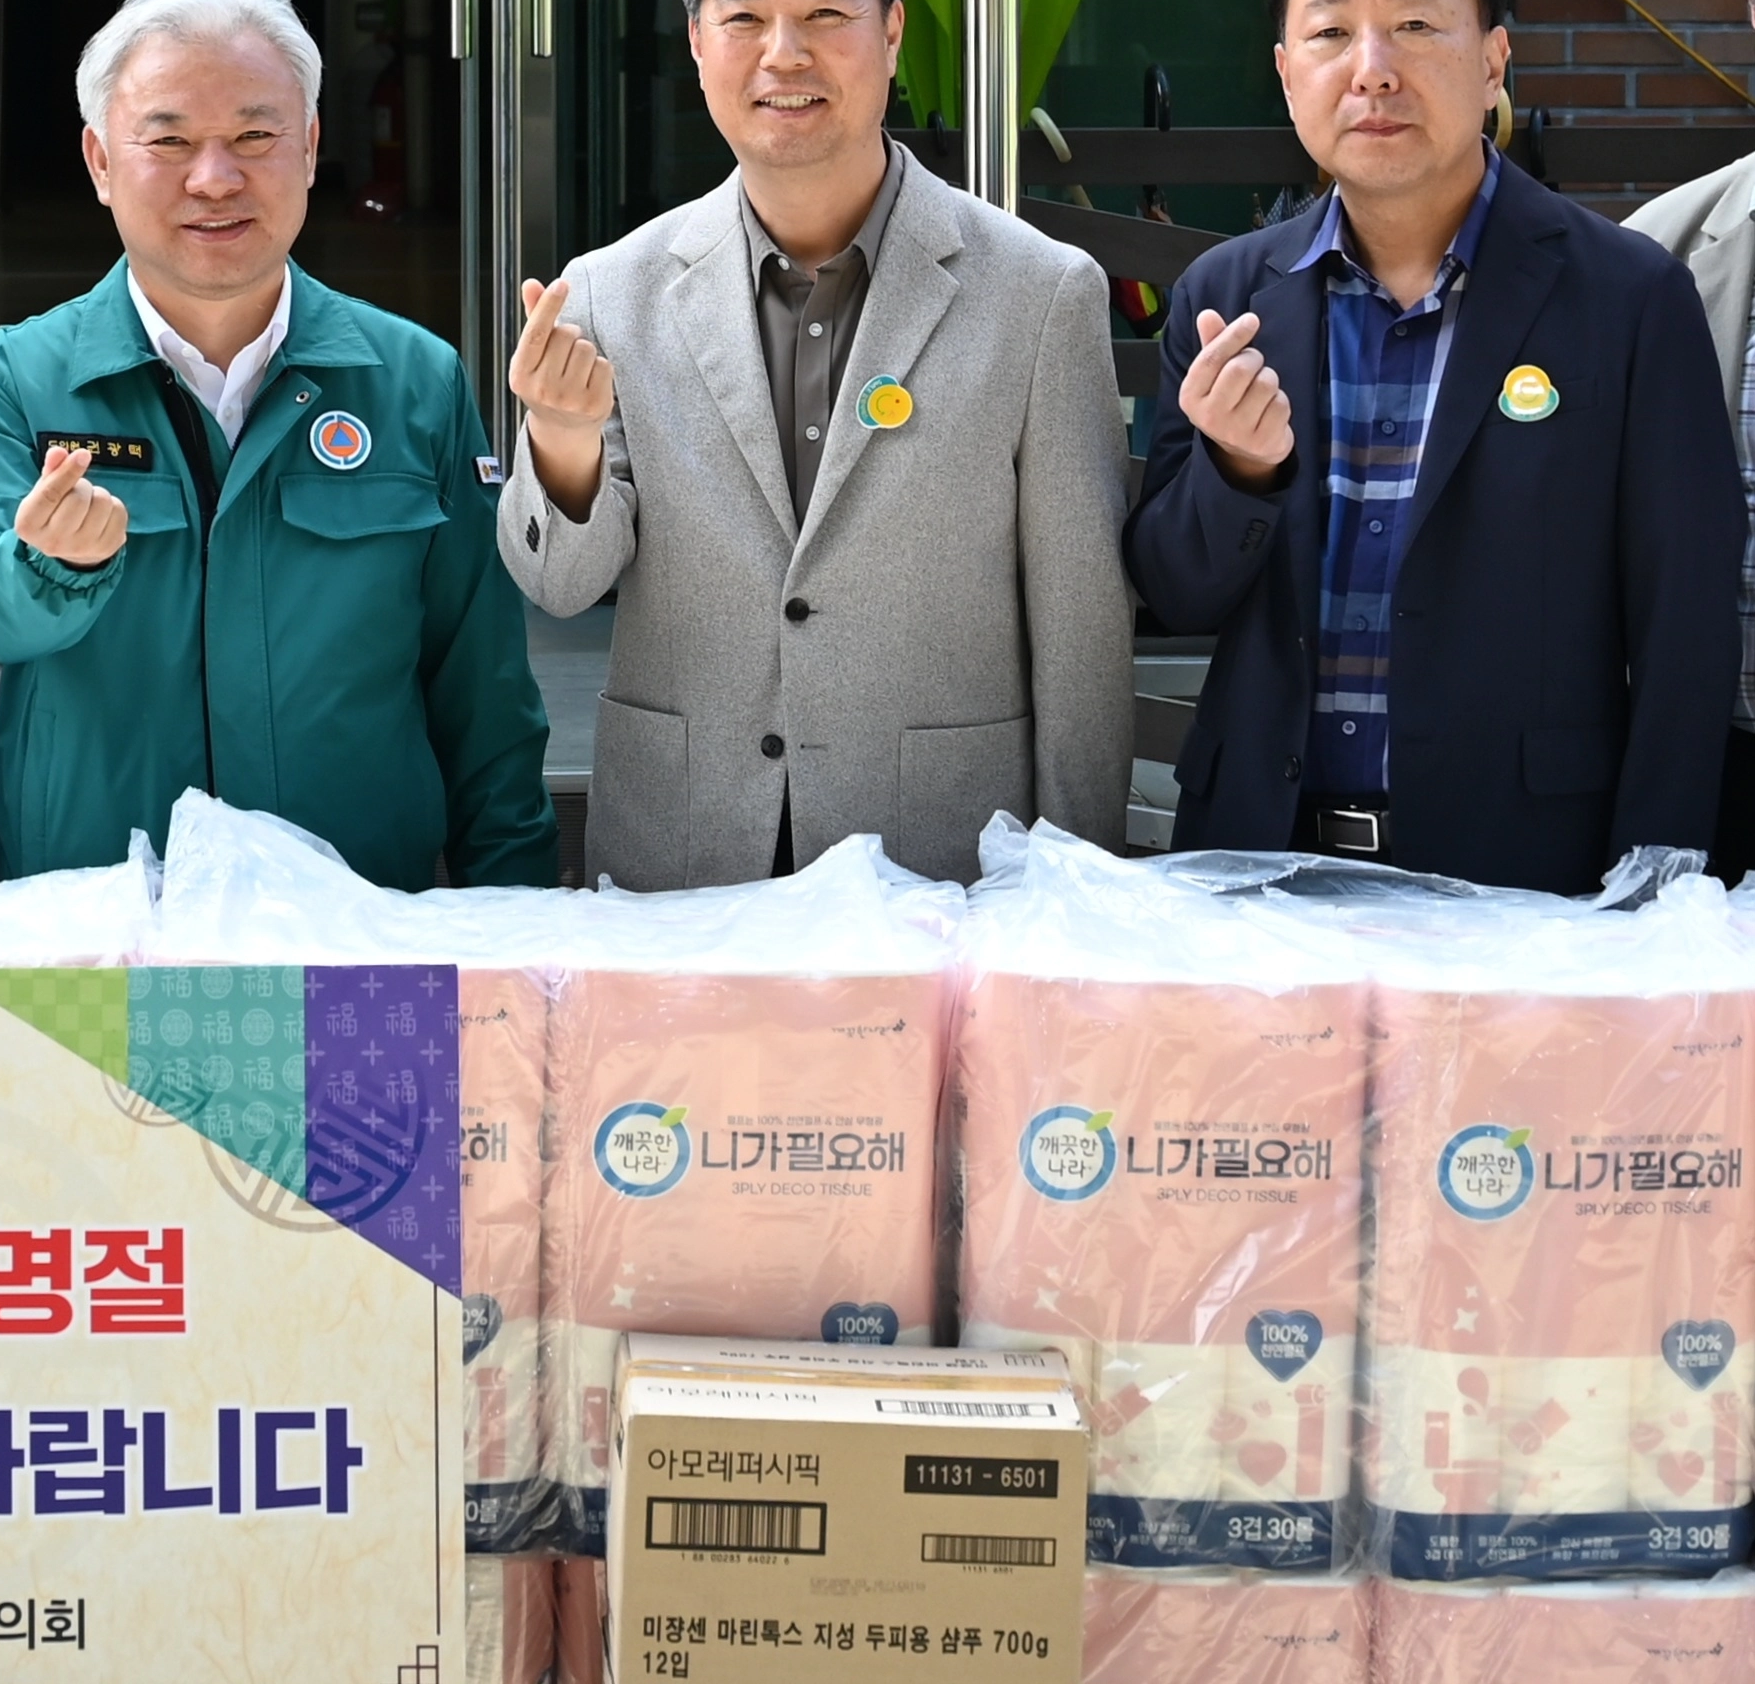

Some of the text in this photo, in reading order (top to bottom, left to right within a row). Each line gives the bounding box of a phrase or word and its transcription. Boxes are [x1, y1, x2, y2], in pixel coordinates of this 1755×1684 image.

[756, 1115, 784, 1126] 100%
[613, 1131, 673, 1154] 깨끗한
[701, 1131, 905, 1173] 니가필요해
[1039, 1134, 1099, 1156] 깨끗한
[622, 1155, 660, 1175] 나라
[1048, 1157, 1087, 1179] 나라
[1126, 1136, 1332, 1180] 니가필요해
[1456, 1153, 1517, 1175] 깨끗한
[1544, 1148, 1742, 1192] 니가필요해
[731, 1182, 873, 1197] 3PLY DECO TISSUE
[1157, 1187, 1299, 1204] 3PLY DECO TISSUE
[1466, 1177, 1504, 1197] 나라
[1575, 1201, 1712, 1216] 3PLY DECO TISSUE
[836, 1316, 885, 1336] 100%
[1260, 1324, 1309, 1343] 100%
[1676, 1334, 1723, 1353] 100%
[647, 1448, 821, 1487] 아모레퍼시픽
[916, 1464, 974, 1486] 11131
[1000, 1466, 1047, 1489] 6501
[464, 1497, 498, 1524] 0롤
[1228, 1517, 1262, 1542] 3겹
[1648, 1527, 1682, 1551] 3겹
[1510, 1535, 1538, 1548] 100%
[718, 1617, 803, 1648] 마린톡스
[813, 1621, 855, 1651] 지성
[865, 1624, 930, 1654] 두피용
[941, 1626, 983, 1656] 샴푸
[993, 1629, 1049, 1659] 700g
[642, 1650, 689, 1679] 12입
